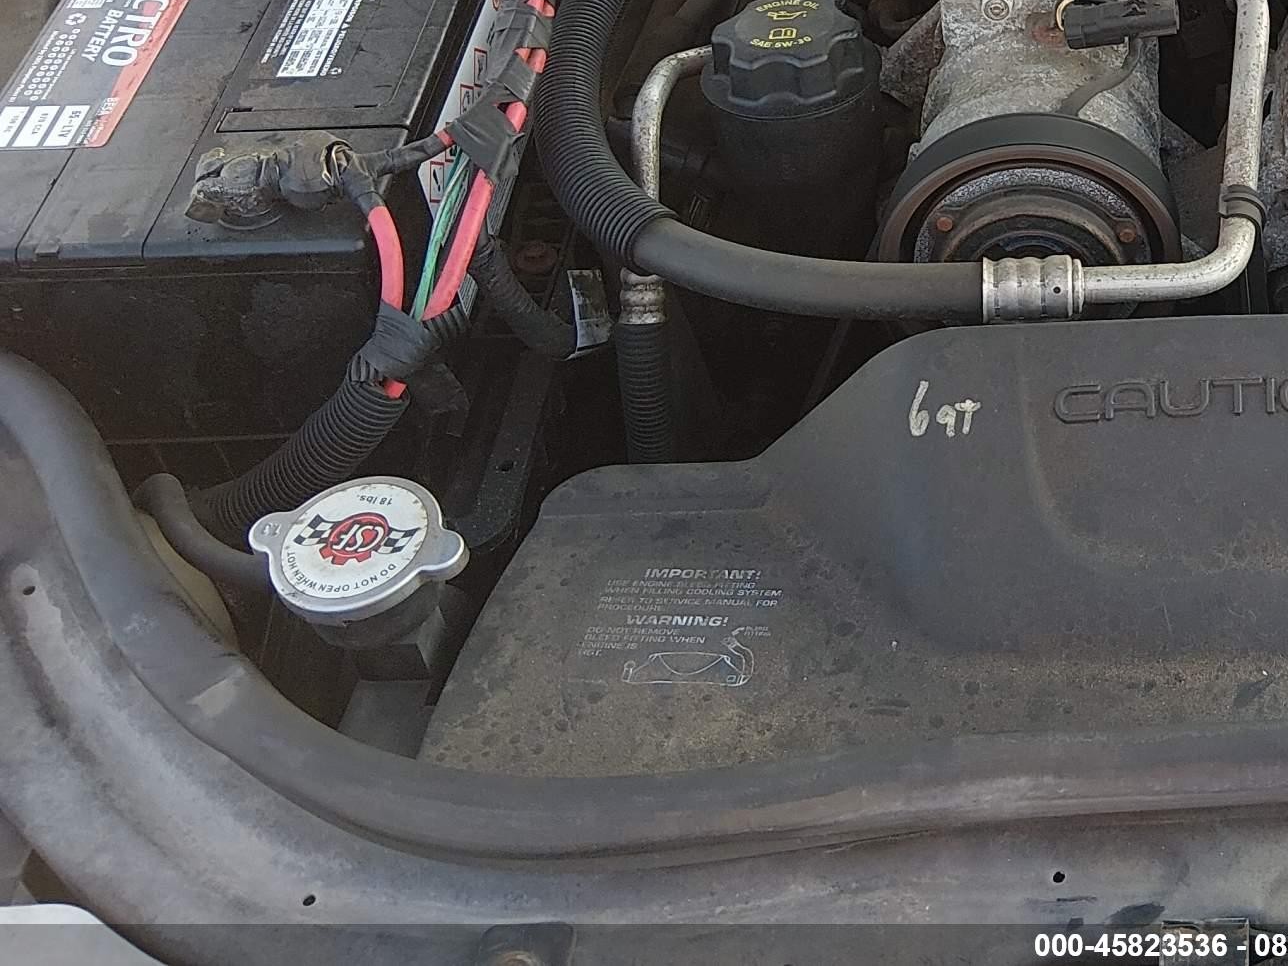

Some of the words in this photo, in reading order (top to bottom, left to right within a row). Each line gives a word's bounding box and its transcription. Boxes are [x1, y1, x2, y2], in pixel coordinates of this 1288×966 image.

[756, 0, 801, 12] ENGINE
[803, 1, 820, 10] OIL
[82, 9, 124, 62] BATTERY
[750, 38, 773, 48] SAE
[379, 497, 394, 506] 18
[333, 524, 384, 553] CSF
[287, 552, 297, 570] HOT
[380, 563, 397, 577] DO
[644, 568, 761, 580] IMPORTANT!
[293, 569, 317, 589] WHEN
[354, 575, 378, 590] NOT
[318, 584, 350, 593] OPEN
[686, 588, 734, 596] COOLING
[655, 597, 701, 605] SERVICE
[704, 599, 751, 607] MANUAL
[756, 599, 778, 607] FOR
[626, 615, 729, 627] WARNING!
[587, 626, 604, 634] DO
[606, 626, 630, 634] NOT
[669, 636, 706, 644] WHEN
